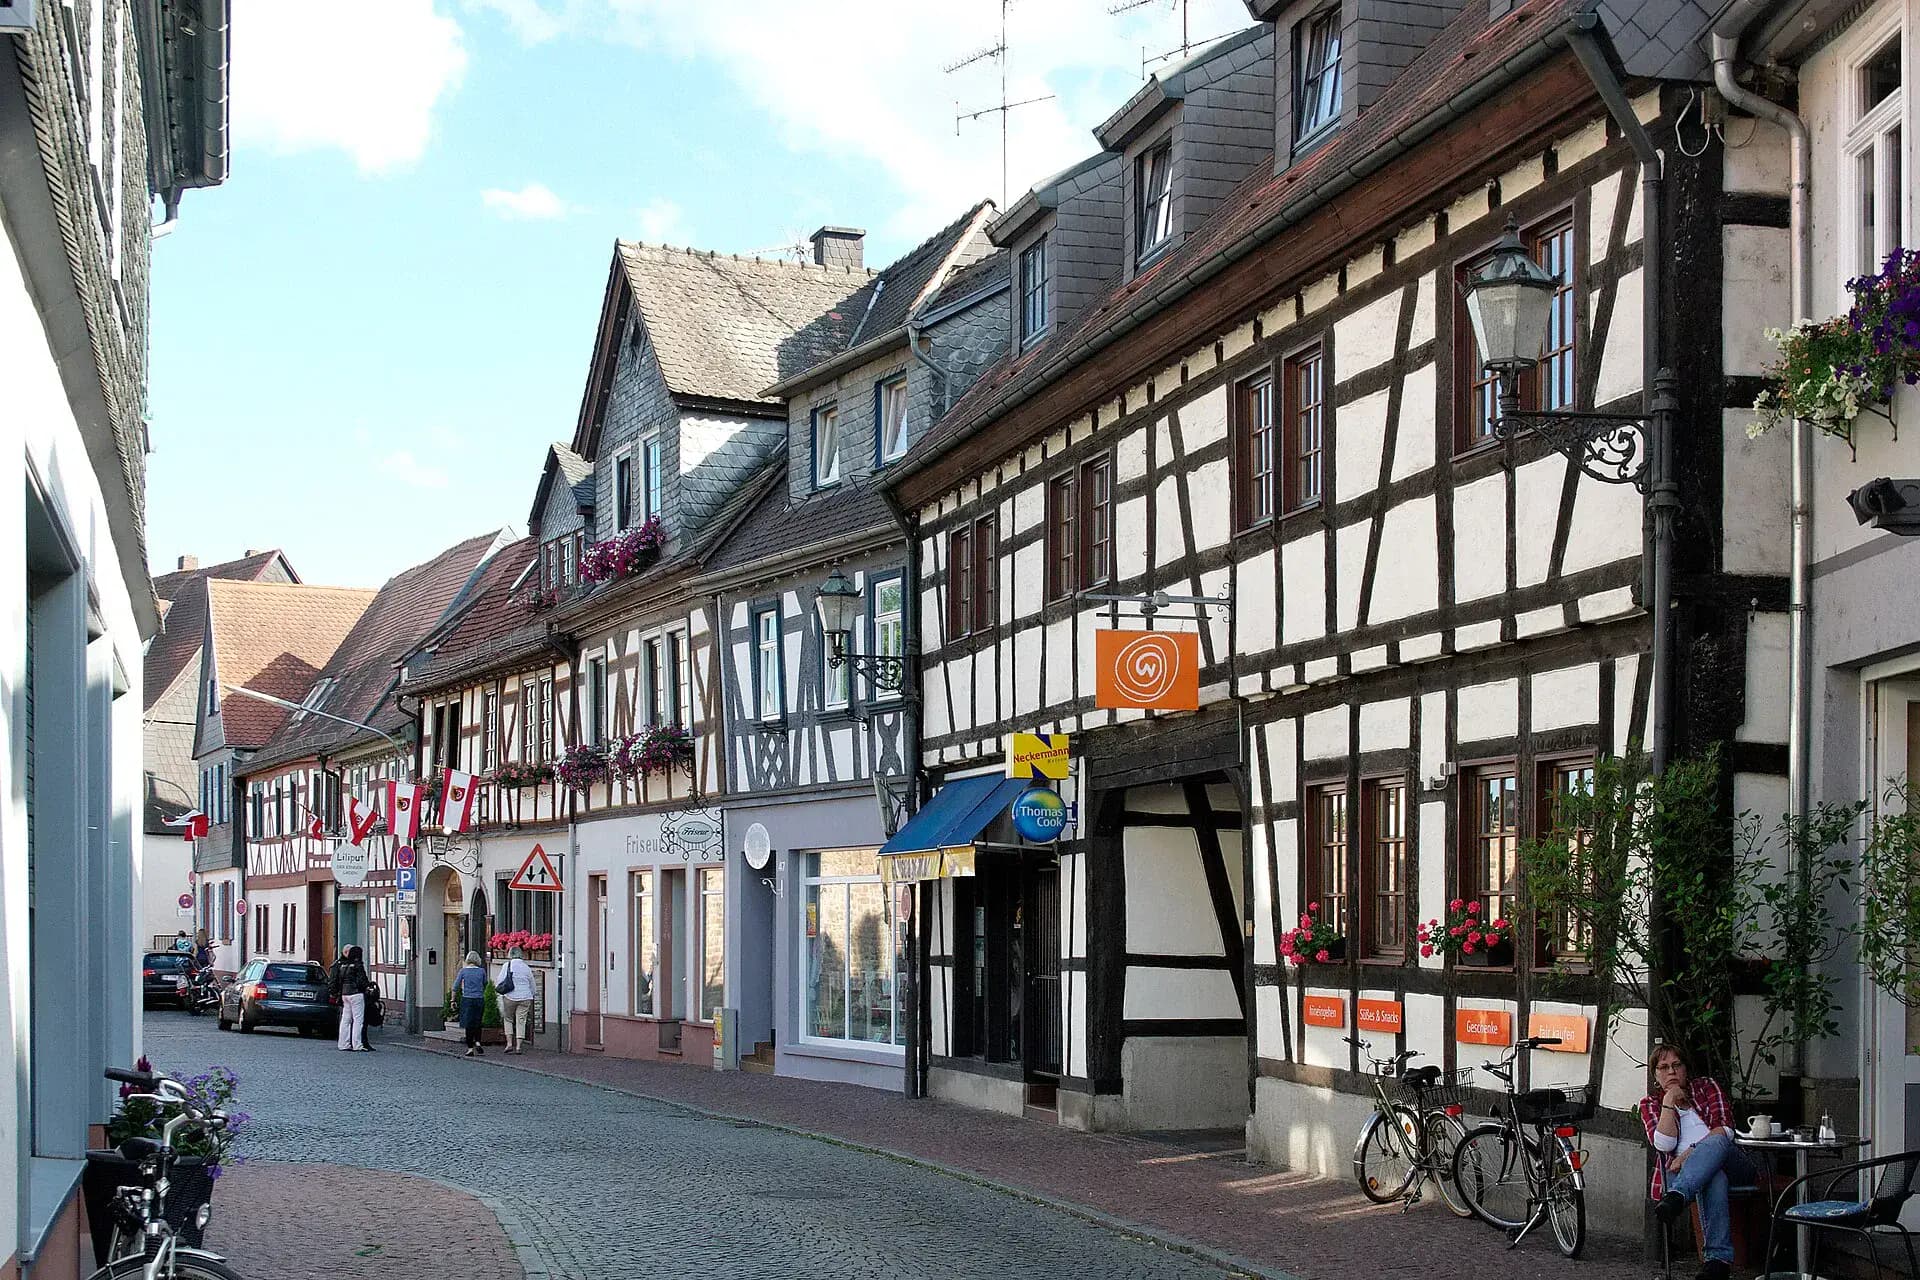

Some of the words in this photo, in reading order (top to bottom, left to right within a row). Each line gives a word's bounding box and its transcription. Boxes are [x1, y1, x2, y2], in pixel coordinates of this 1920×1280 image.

[1014, 747, 1070, 763] Neckermann
[1020, 806, 1063, 817] Thomas
[1037, 816, 1062, 827] Cook
[682, 827, 709, 836] Friseur
[337, 853, 364, 863] Liliput
[400, 871, 411, 888] P
[1375, 1009, 1380, 1022] &
[1381, 1010, 1399, 1023] Snacks
[1466, 1020, 1498, 1035] Geschenke
[1539, 1025, 1551, 1038] Fair
[1552, 1027, 1575, 1041] kaufen
